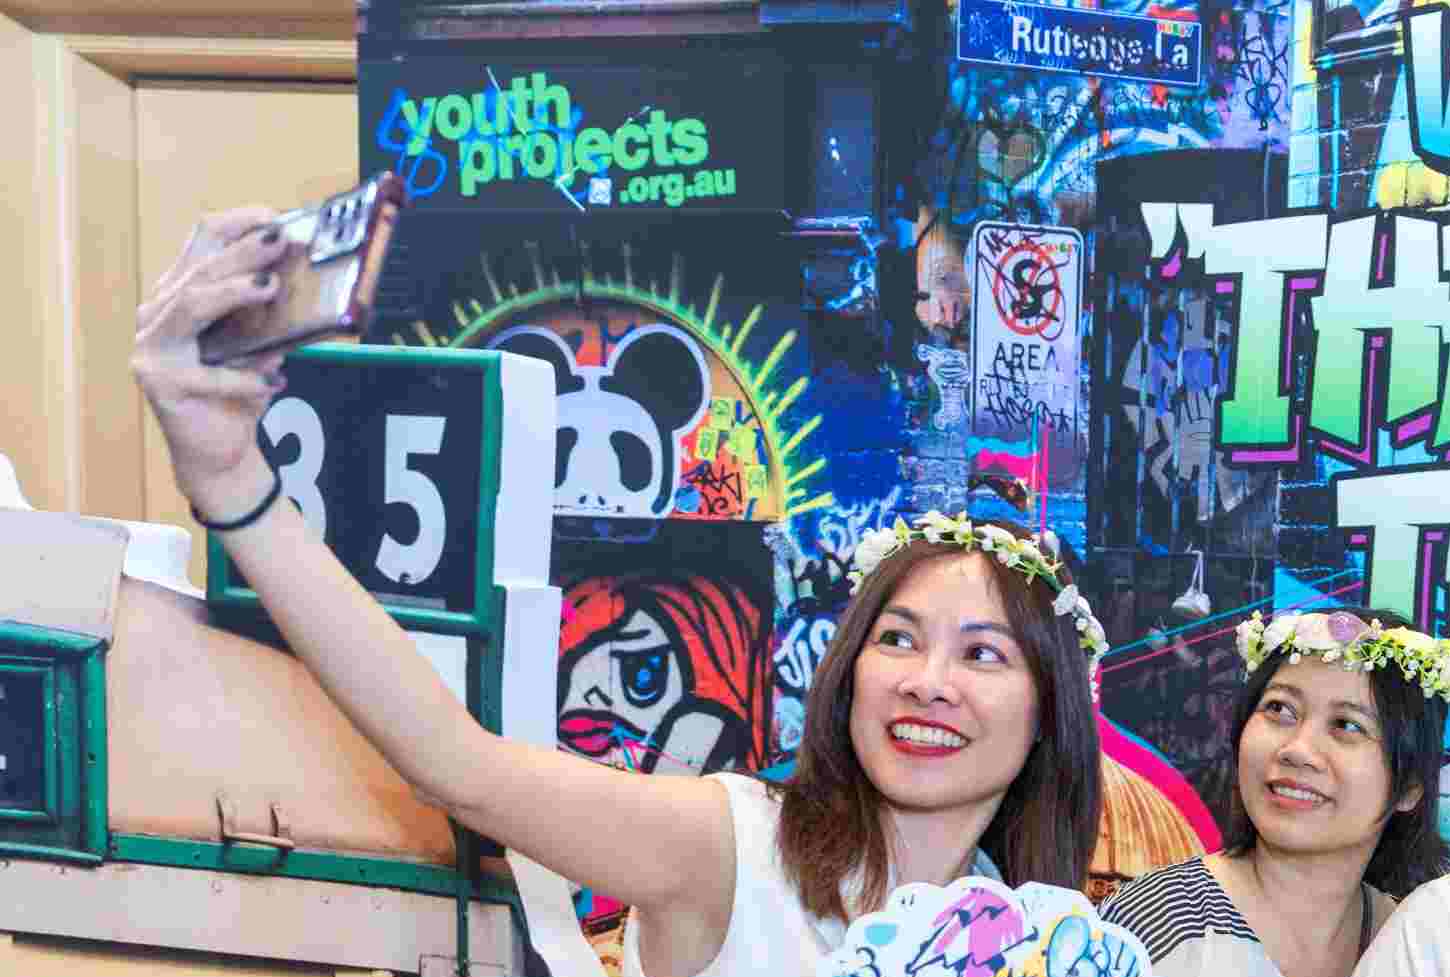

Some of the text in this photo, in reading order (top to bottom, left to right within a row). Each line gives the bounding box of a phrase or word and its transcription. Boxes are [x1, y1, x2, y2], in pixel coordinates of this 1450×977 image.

[401, 72, 571, 155] youth
[460, 110, 709, 197] projects
[619, 168, 737, 207] .org.au
